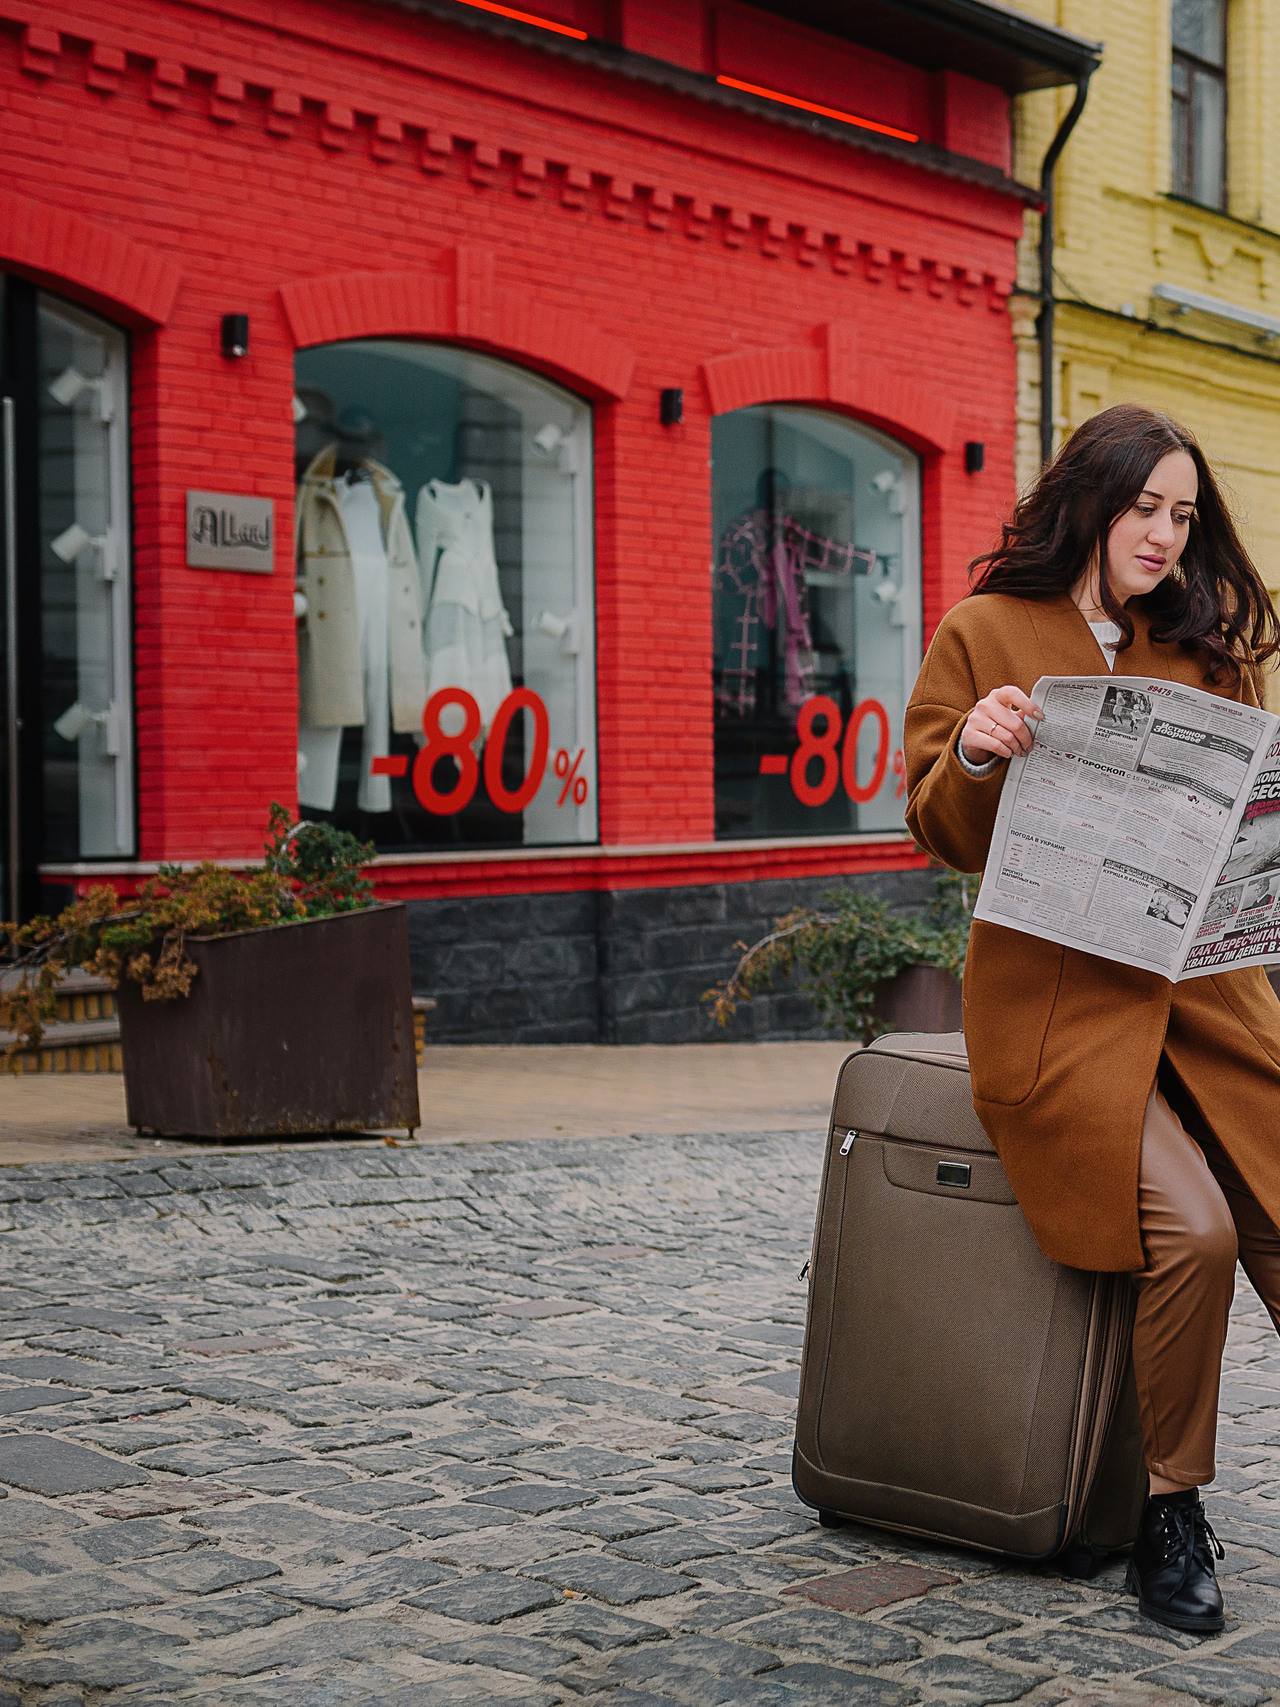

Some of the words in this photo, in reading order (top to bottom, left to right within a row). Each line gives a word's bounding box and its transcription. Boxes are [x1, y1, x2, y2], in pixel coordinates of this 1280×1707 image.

[1147, 685, 1172, 697] 89475
[1153, 725, 1202, 744] Здоровье
[1160, 721, 1207, 740] Истинное
[370, 686, 588, 815] -80%
[1077, 757, 1126, 777] ГОРОСКОП
[1010, 829, 1034, 842] ПОГОДА
[1040, 839, 1066, 852] УКРАИНЕ
[1103, 868, 1124, 879] КУРИЦА
[1129, 876, 1149, 888] БЕКОНЕ
[1184, 952, 1221, 969] ХВАТИТ
[1221, 950, 1235, 964] ЛИ
[1235, 942, 1268, 961] ДЕНЕГ
[1188, 943, 1215, 959] КАК
